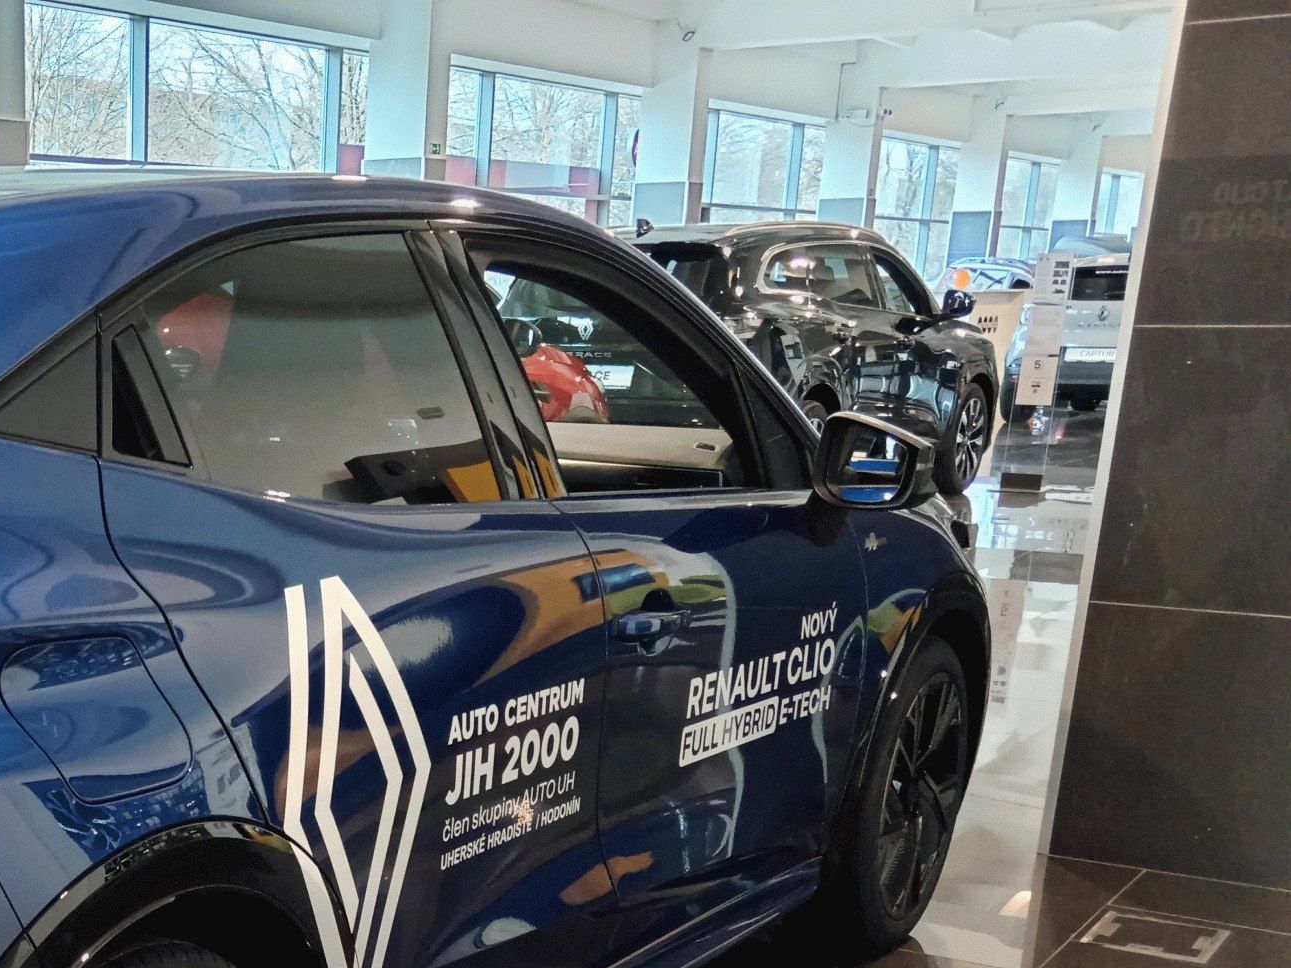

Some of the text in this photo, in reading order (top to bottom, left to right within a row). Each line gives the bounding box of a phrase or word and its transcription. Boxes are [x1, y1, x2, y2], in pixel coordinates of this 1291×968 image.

[800, 601, 838, 640] NOVÝ
[447, 677, 585, 746] AUTO CENTRUM
[686, 638, 836, 719] RENAULT CLIO
[682, 685, 832, 760] FULL HYBRID E-TECH
[445, 715, 580, 806] JIH 2000
[440, 835, 486, 871] UHERSKÉ
[540, 797, 581, 827] HODONÍN
[442, 770, 576, 842] člen skupiny AUTO UH
